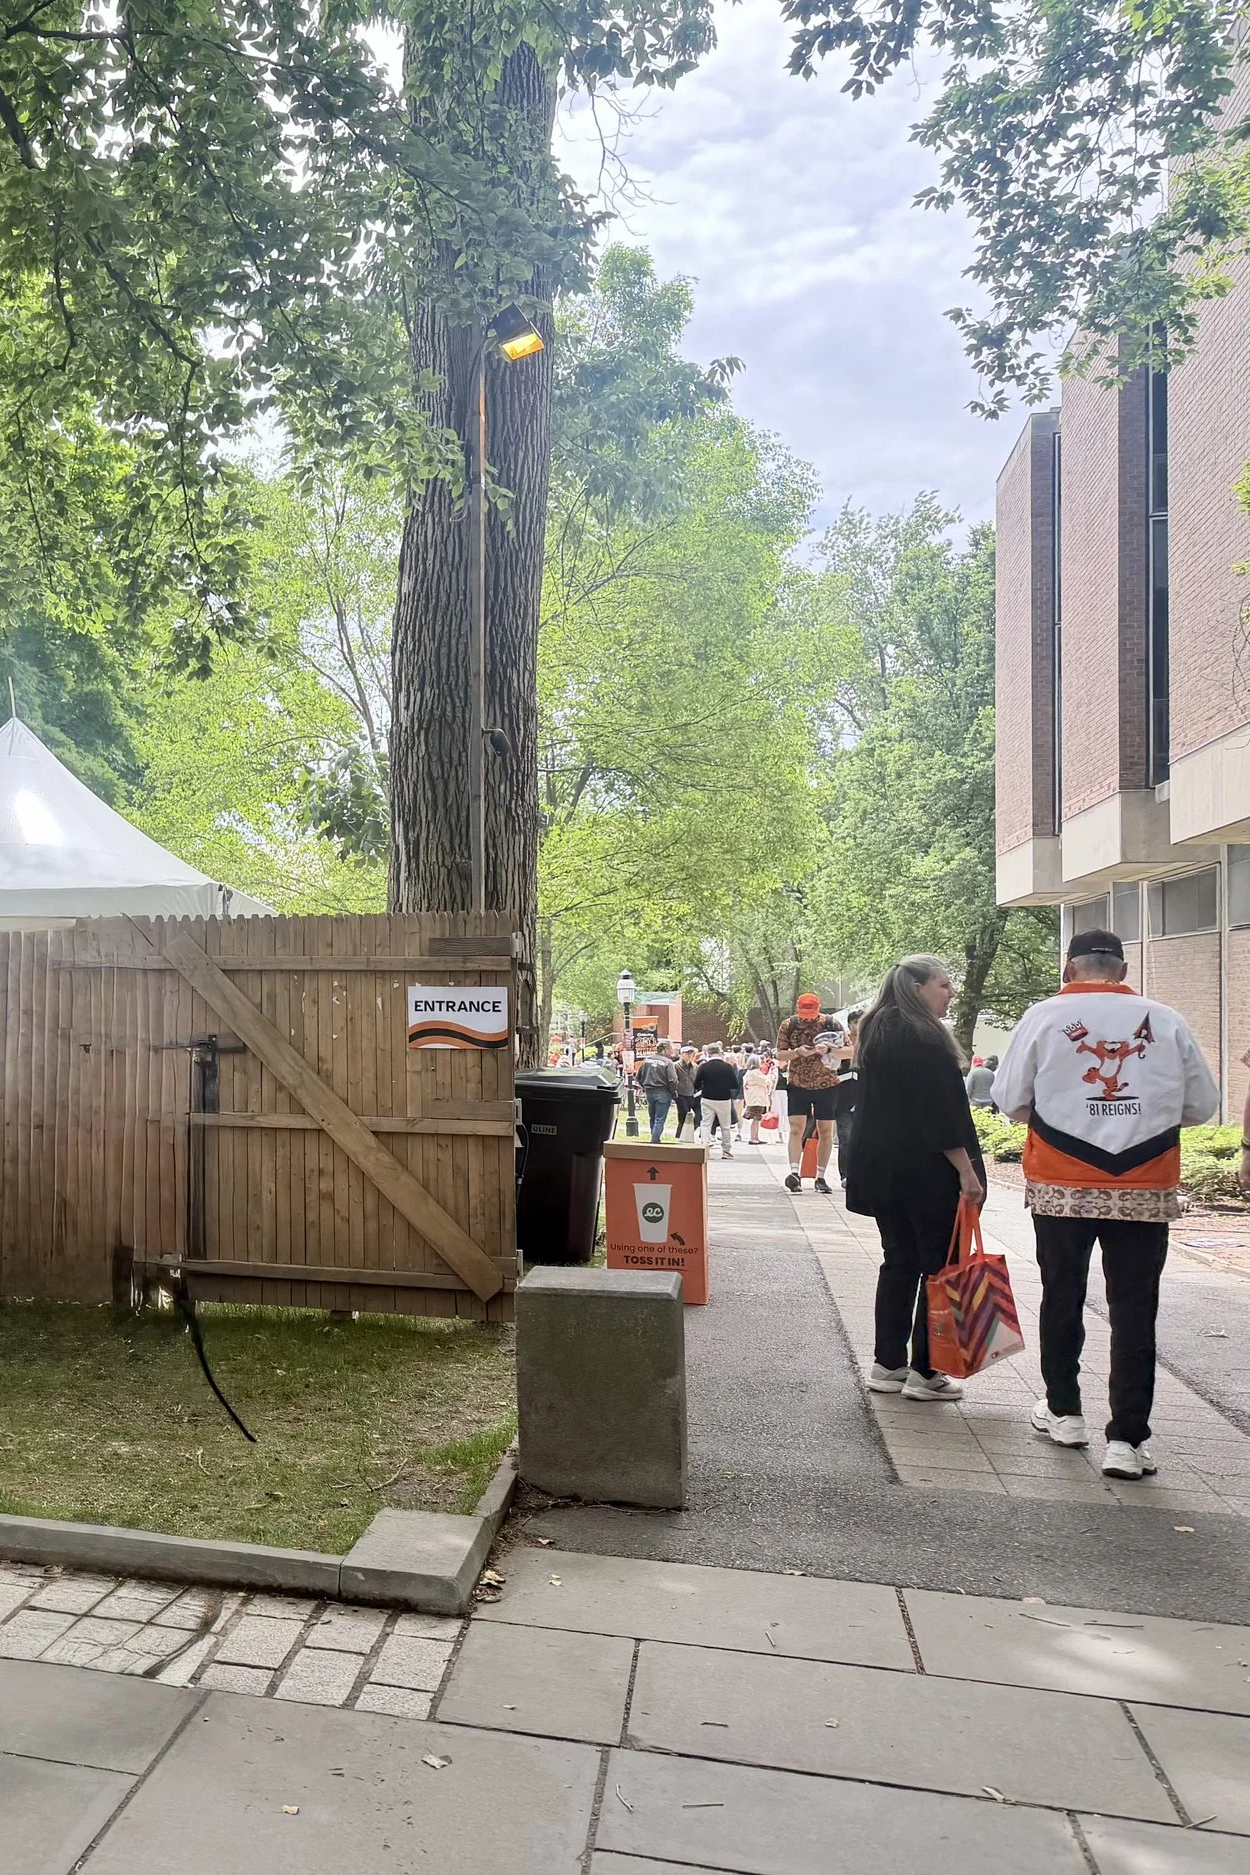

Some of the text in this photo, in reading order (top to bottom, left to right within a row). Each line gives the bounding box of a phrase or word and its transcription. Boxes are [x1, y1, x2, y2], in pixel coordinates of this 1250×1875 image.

[414, 1000, 502, 1013] ENTRANCE
[1086, 1103, 1141, 1116] '81 REIGNS!
[610, 1243, 699, 1255] Using one of these?
[623, 1255, 685, 1267] TOSS IT IN!
